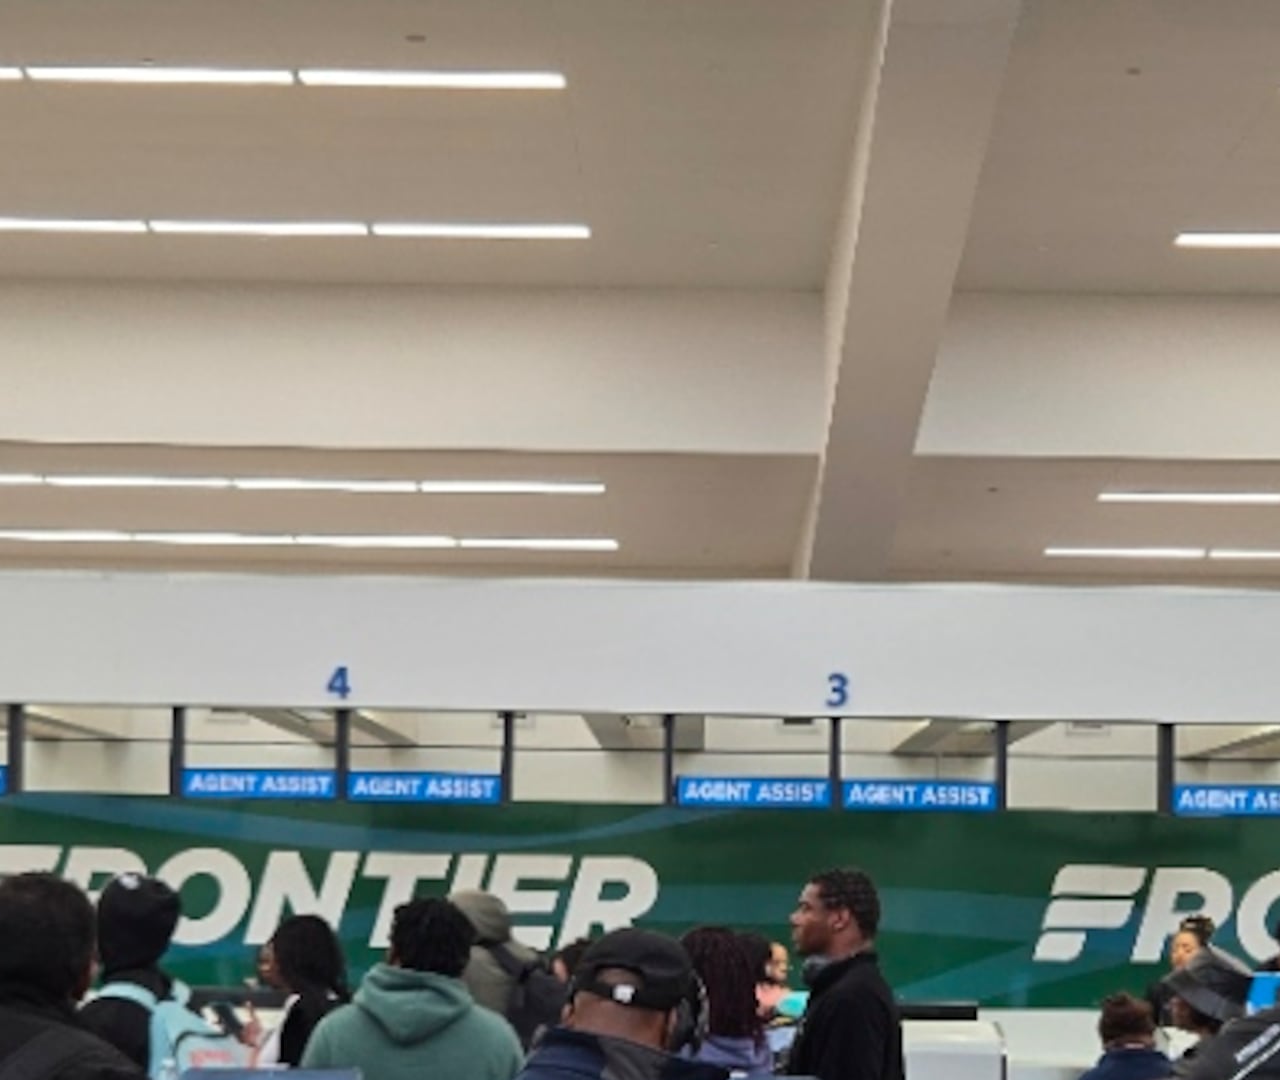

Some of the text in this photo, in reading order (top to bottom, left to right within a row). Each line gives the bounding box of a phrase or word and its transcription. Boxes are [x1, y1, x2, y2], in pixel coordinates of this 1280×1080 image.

[327, 666, 351, 699] 4
[826, 673, 849, 707] 3
[189, 774, 330, 794] AGENT ASSIST
[353, 778, 495, 798] AGENT ASSIST
[685, 782, 826, 802] AGENT ASSIST
[849, 786, 993, 806] AGENT ASSIST
[1178, 790, 1247, 810] AGENT
